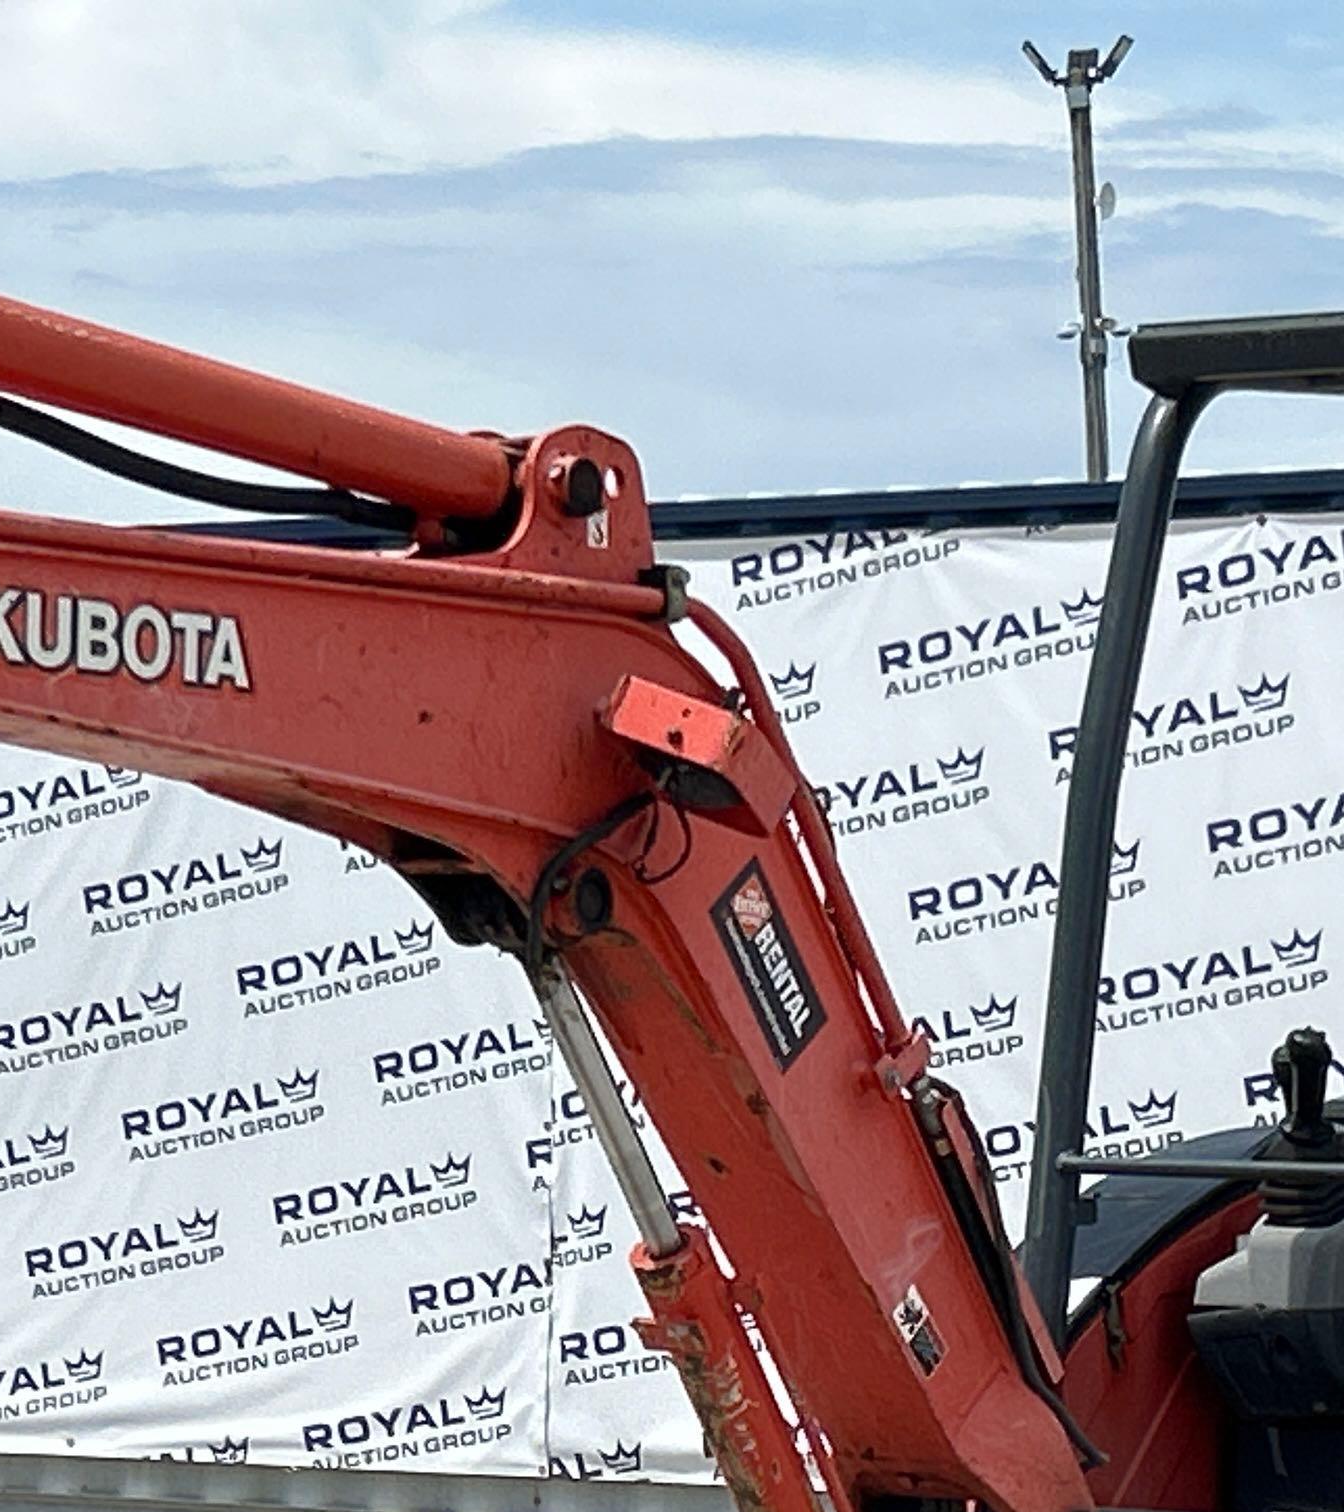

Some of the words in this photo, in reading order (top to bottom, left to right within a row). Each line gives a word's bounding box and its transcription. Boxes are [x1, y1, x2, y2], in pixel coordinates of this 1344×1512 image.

[737, 565, 856, 611] AUCTION
[863, 538, 960, 577] GROUP
[1183, 578, 1315, 625] AUCTION
[879, 607, 1061, 674] ROYAL
[885, 655, 1008, 698] AUCTION
[1013, 635, 1097, 668] GROU
[1190, 715, 1294, 753] GROUP
[67, 790, 150, 824] GROUP
[893, 786, 989, 823] GROUP
[83, 853, 239, 914] ROYAL
[91, 897, 198, 936] AUCTION
[203, 874, 288, 908] GROUP
[908, 862, 1059, 920] ROYA
[916, 903, 1038, 944] AUCTION
[237, 936, 392, 995] ROYAL
[244, 979, 351, 1018] AUCTION
[357, 957, 440, 991] GROUP
[755, 922, 811, 1039] RENTAL
[1224, 970, 1329, 1008] GROUP
[104, 1019, 187, 1050] GROUP
[373, 1024, 533, 1083] ROYAL
[121, 1083, 276, 1140] ROYAL
[382, 1068, 486, 1106] AUCTION
[130, 1126, 235, 1161] AUCTION
[240, 1105, 324, 1137] GROUP
[273, 1168, 428, 1224] ROYAL
[280, 1210, 387, 1247] AUCTION
[392, 1191, 477, 1222] GROUP
[25, 1224, 176, 1277] ROYAL
[33, 1264, 136, 1299] AUCTION
[140, 1246, 224, 1276] GROUP
[156, 1311, 311, 1366] ROYAL
[416, 1302, 524, 1336] AUCTION
[163, 1353, 268, 1386] AUCTION
[275, 1335, 359, 1365] GROUP
[26, 1387, 107, 1414] GROUP
[303, 1399, 463, 1452] ROYAL
[424, 1424, 511, 1453] GROUP
